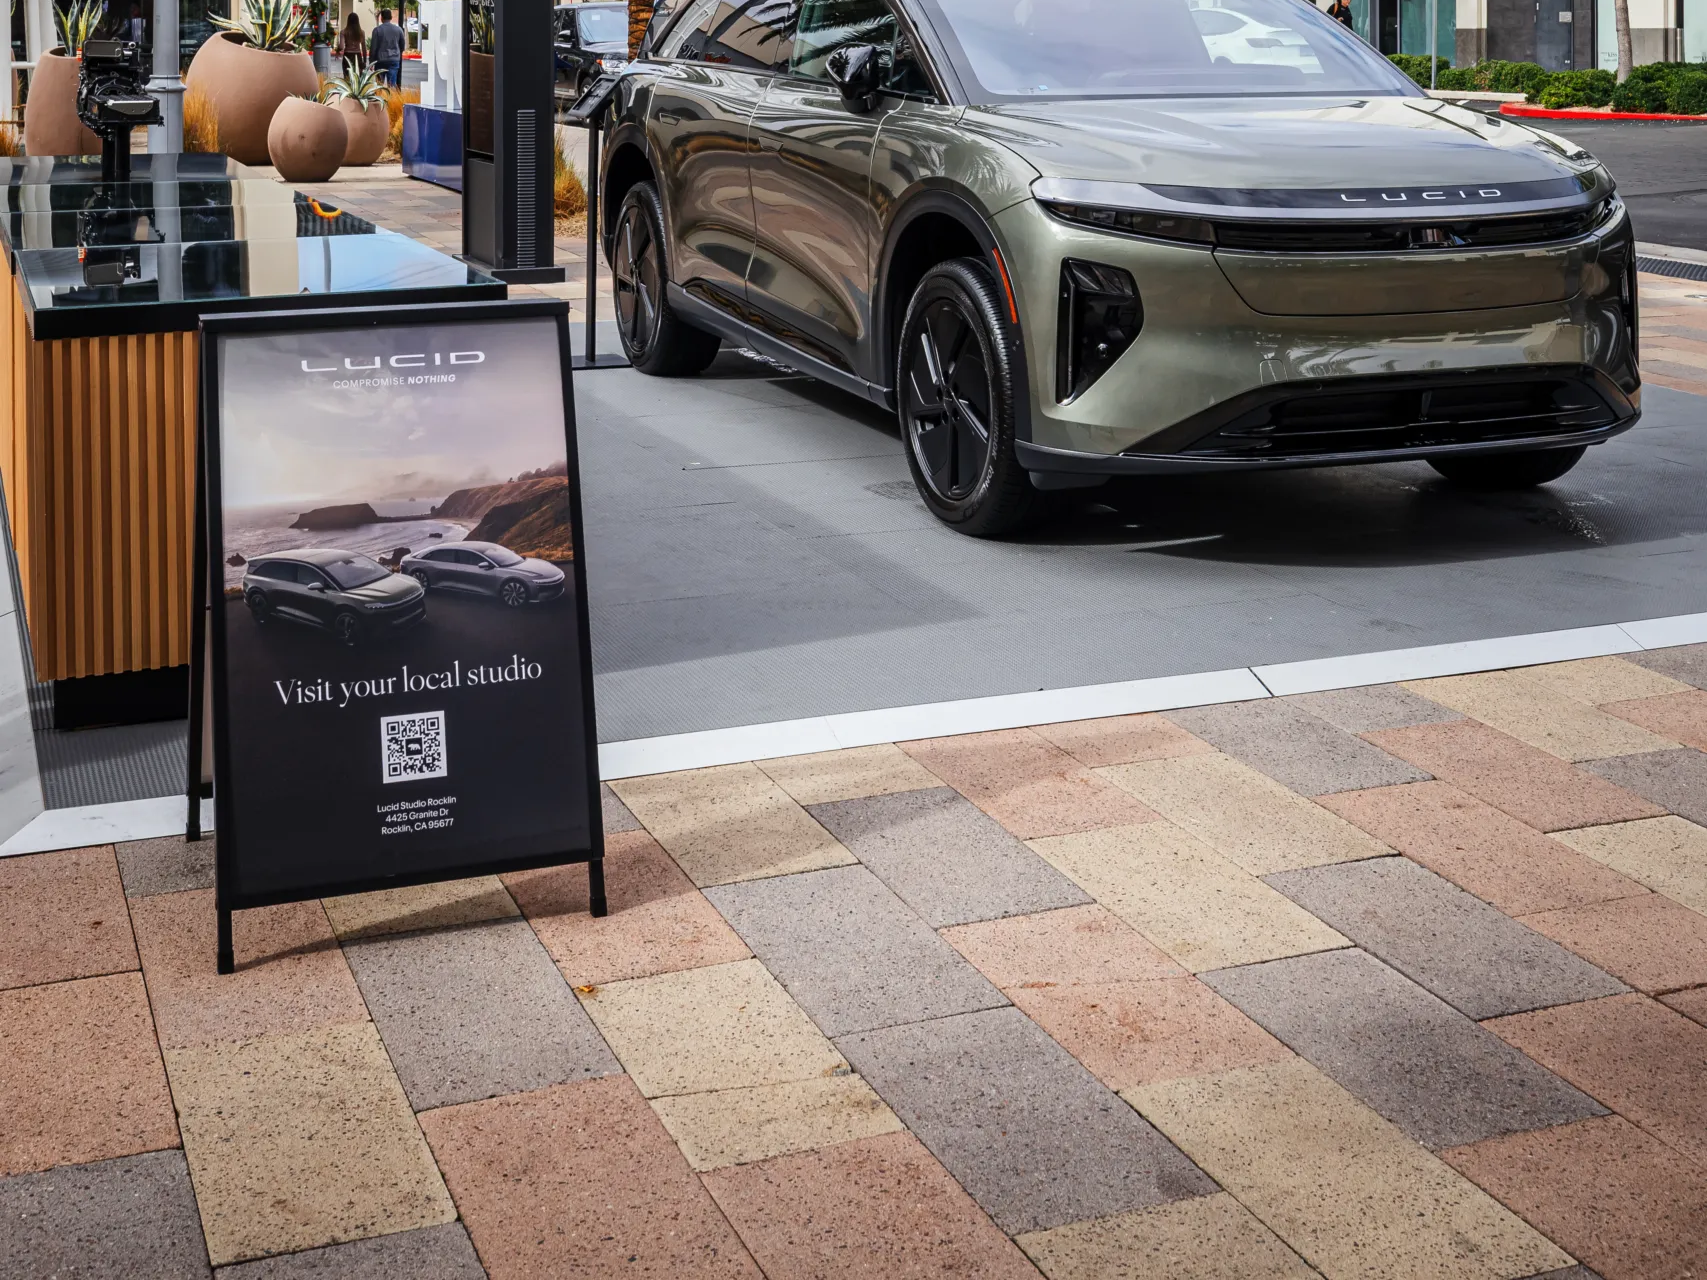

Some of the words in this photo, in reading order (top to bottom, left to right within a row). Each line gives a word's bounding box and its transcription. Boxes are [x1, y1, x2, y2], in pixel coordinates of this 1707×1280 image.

[1340, 189, 1501, 202] LUCID
[301, 351, 486, 372] LUCID
[333, 376, 405, 389] COMPROMISE
[407, 374, 456, 385] NOTHING
[273, 678, 334, 706] Visit
[339, 675, 397, 708] your
[401, 660, 461, 692] local
[467, 654, 542, 686] studio
[376, 802, 400, 813] Lucid
[400, 799, 427, 810] Studio
[427, 796, 457, 807] Rocklin
[385, 812, 408, 823] 4425
[409, 809, 439, 820] Granite
[439, 807, 449, 817] Dr
[381, 824, 413, 835] Rocklin,
[414, 821, 428, 831] CA
[428, 817, 454, 829] 95677
